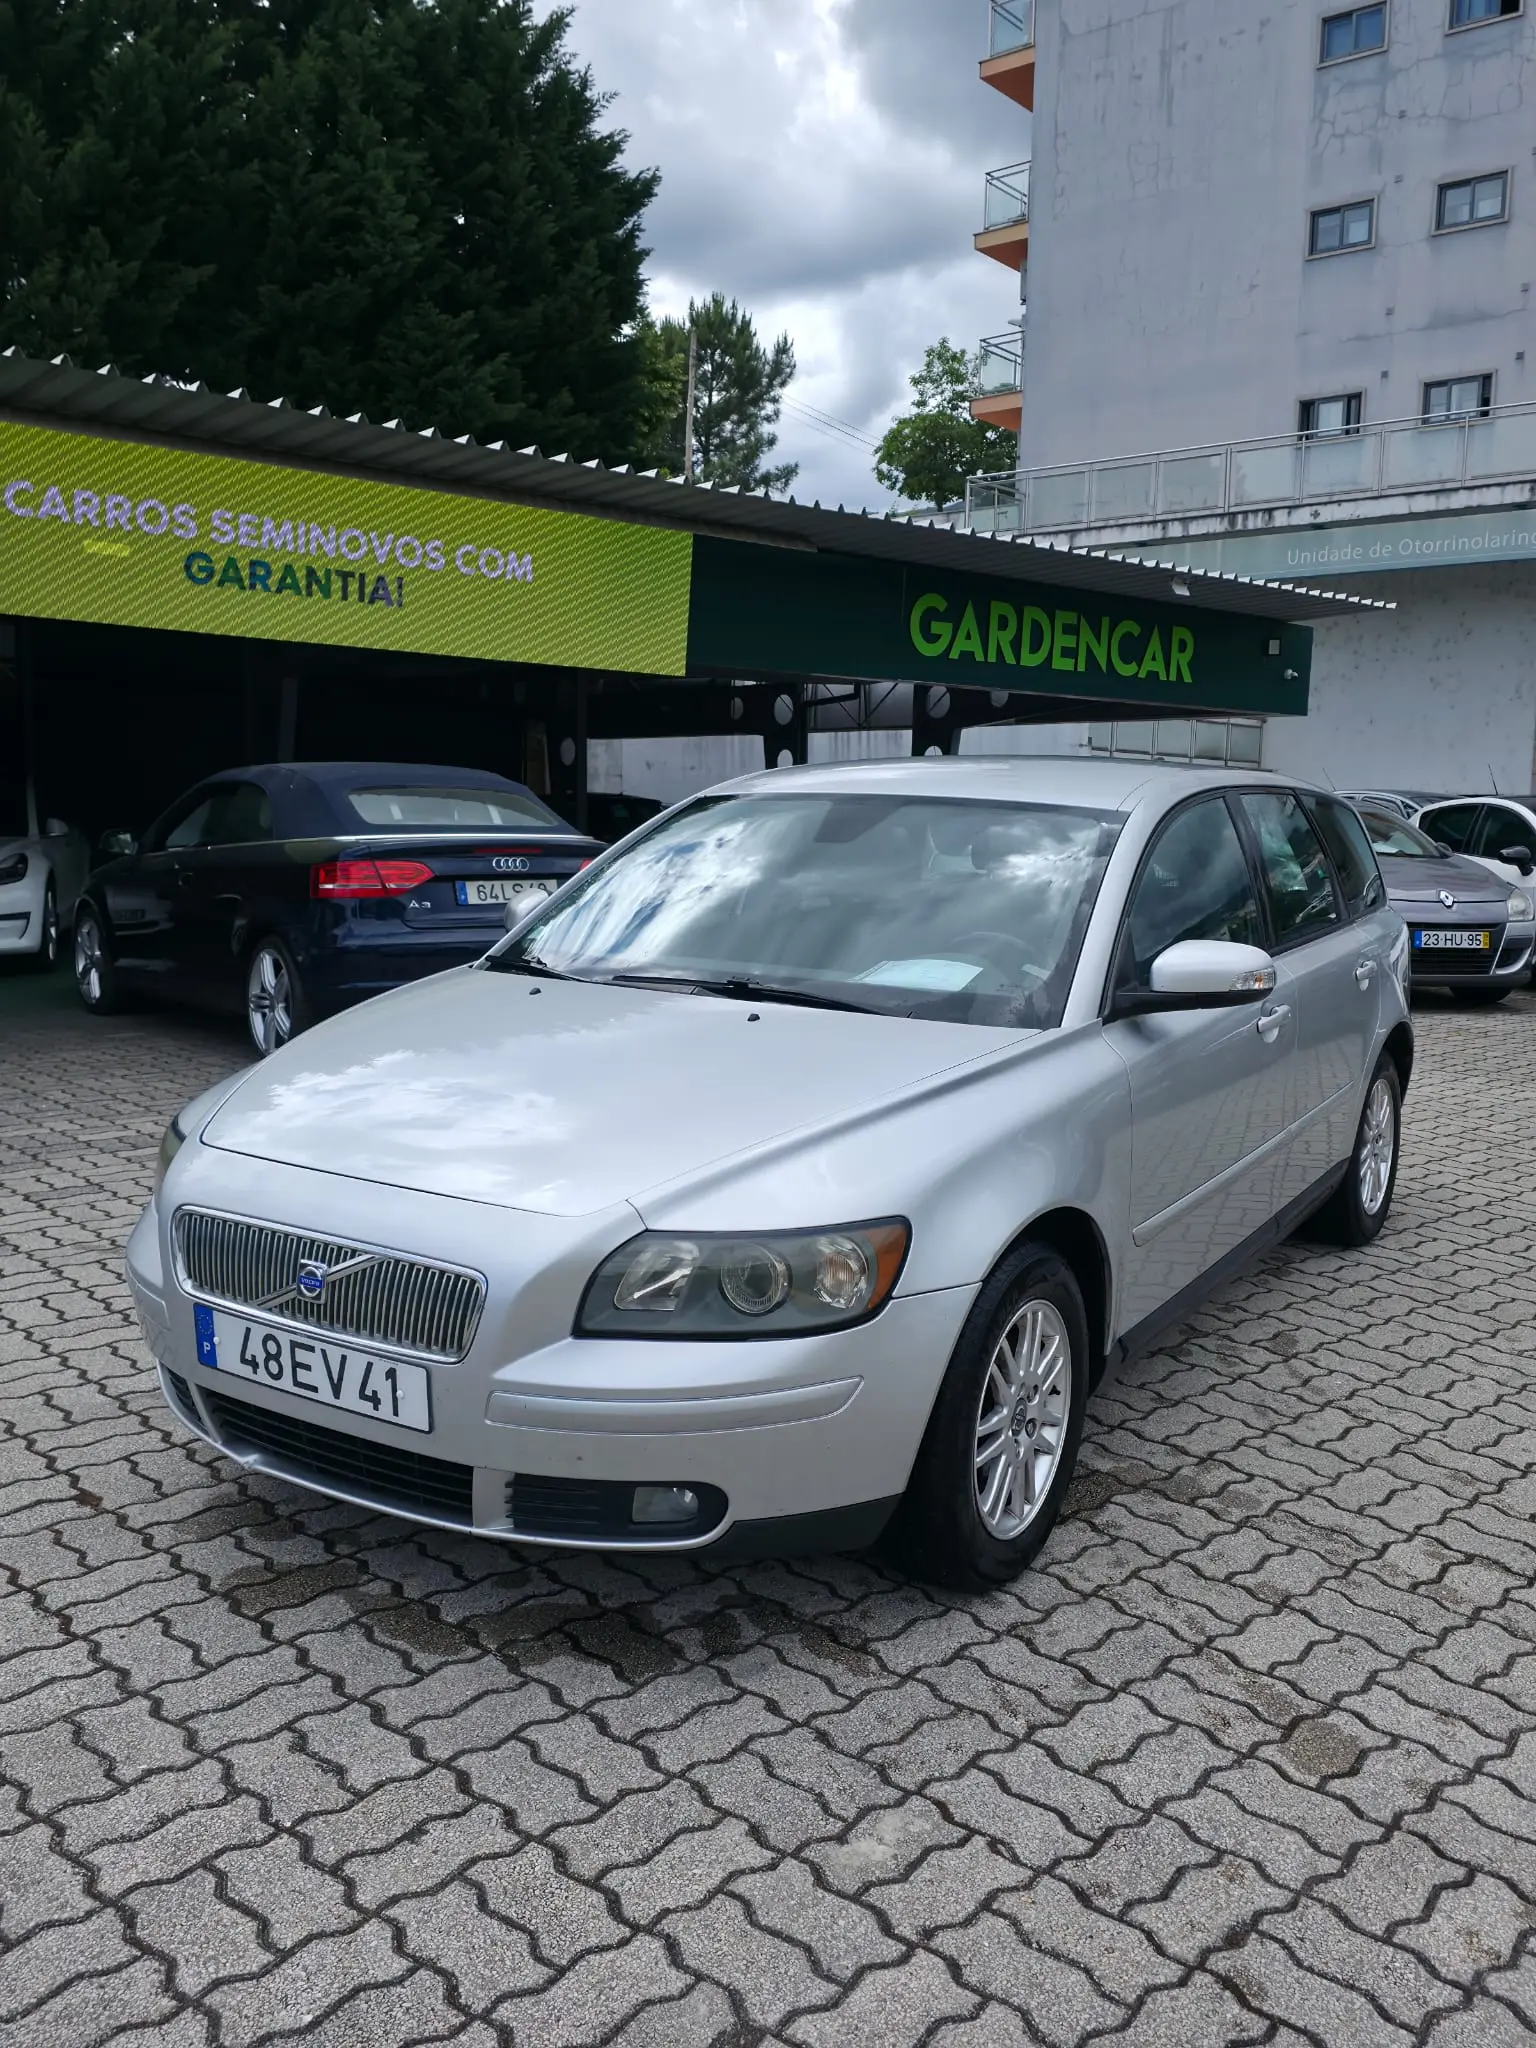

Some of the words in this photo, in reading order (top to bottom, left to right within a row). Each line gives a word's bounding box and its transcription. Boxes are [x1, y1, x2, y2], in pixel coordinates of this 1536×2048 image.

[3, 480, 198, 540] CARROS
[210, 509, 446, 571] SEMINOVOS
[454, 543, 533, 582] COM
[1287, 544, 1362, 566] Unidade
[1369, 541, 1392, 557] de
[184, 551, 405, 608] GARANTIA!
[910, 593, 1195, 683] GARDENCAR
[408, 900, 431, 909] A3
[203, 1341, 211, 1354] P
